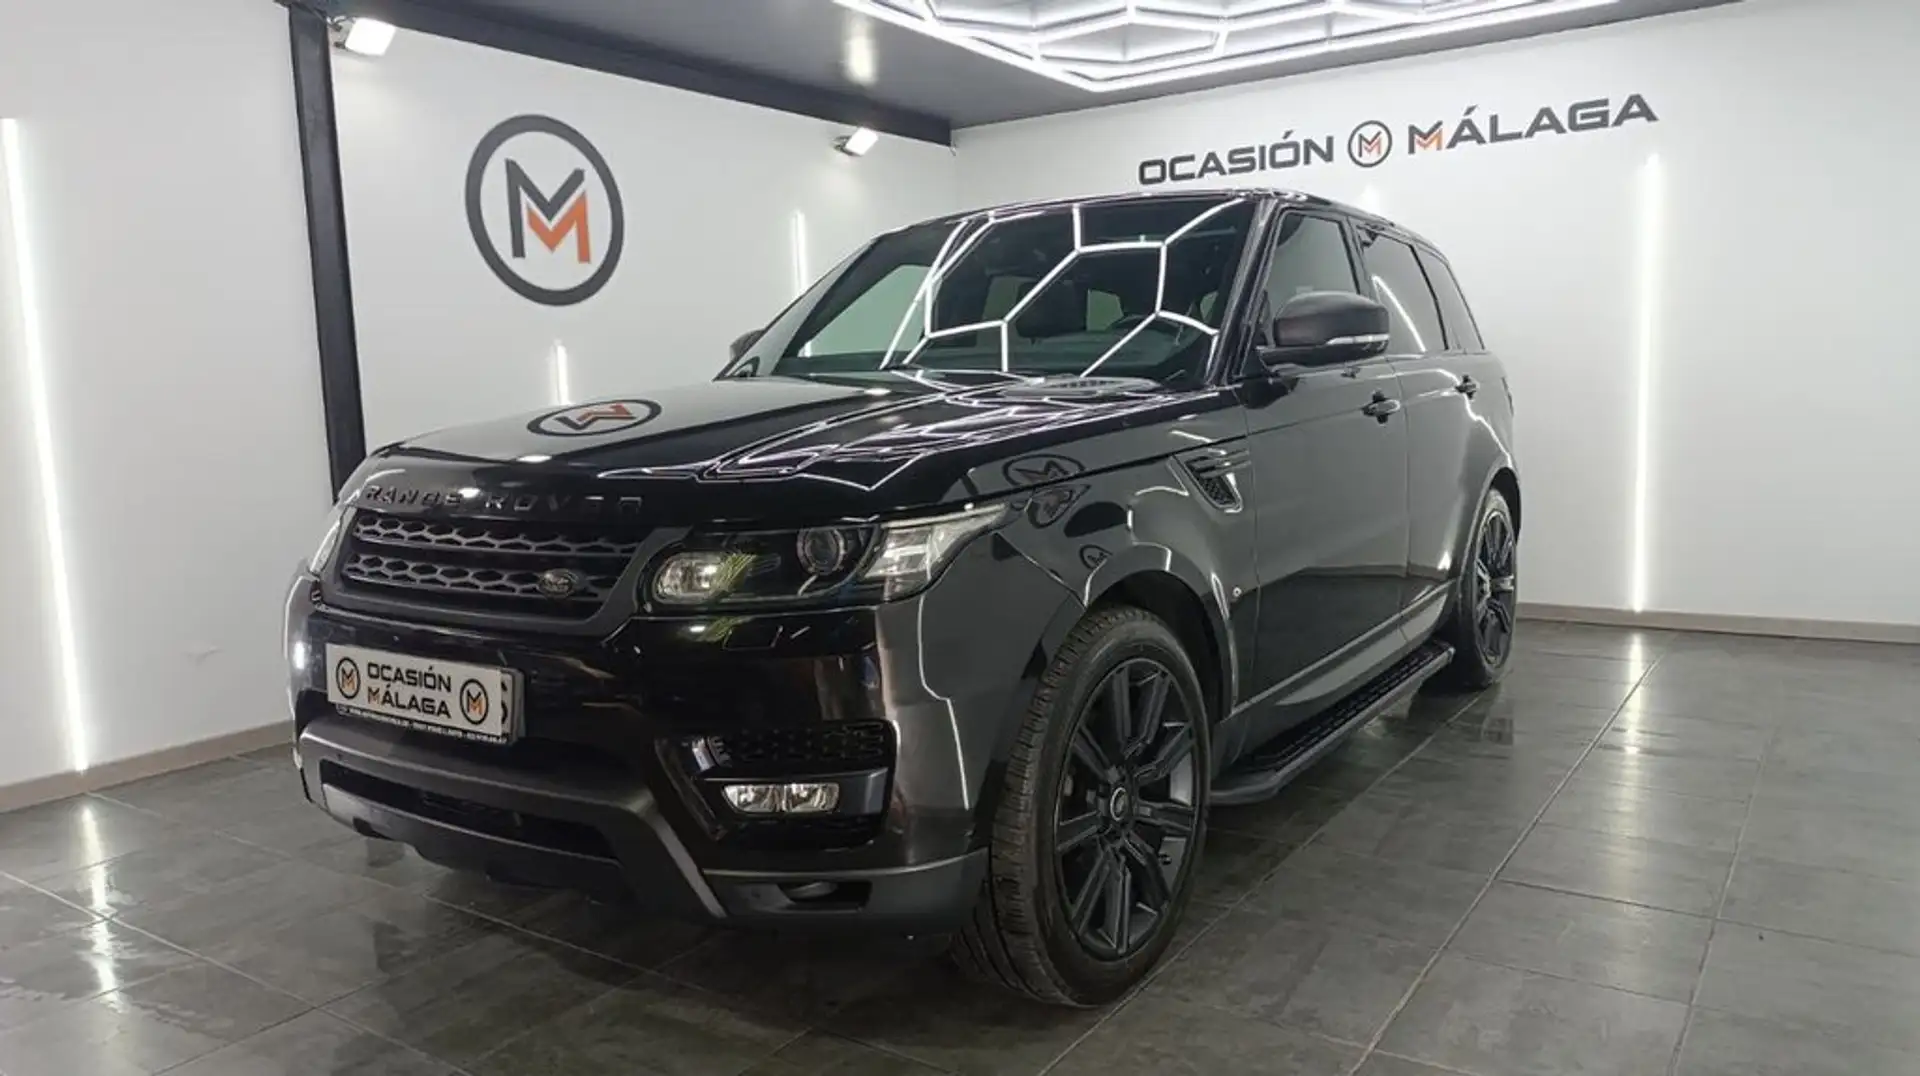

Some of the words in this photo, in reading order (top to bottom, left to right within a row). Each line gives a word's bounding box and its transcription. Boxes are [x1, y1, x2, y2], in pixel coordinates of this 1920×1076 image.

[1138, 130, 1334, 185] OCASIÓN
[1408, 93, 1658, 155] MÁLAGA
[367, 662, 452, 692] OCASIÓN
[367, 683, 452, 719] MÁLAGA
